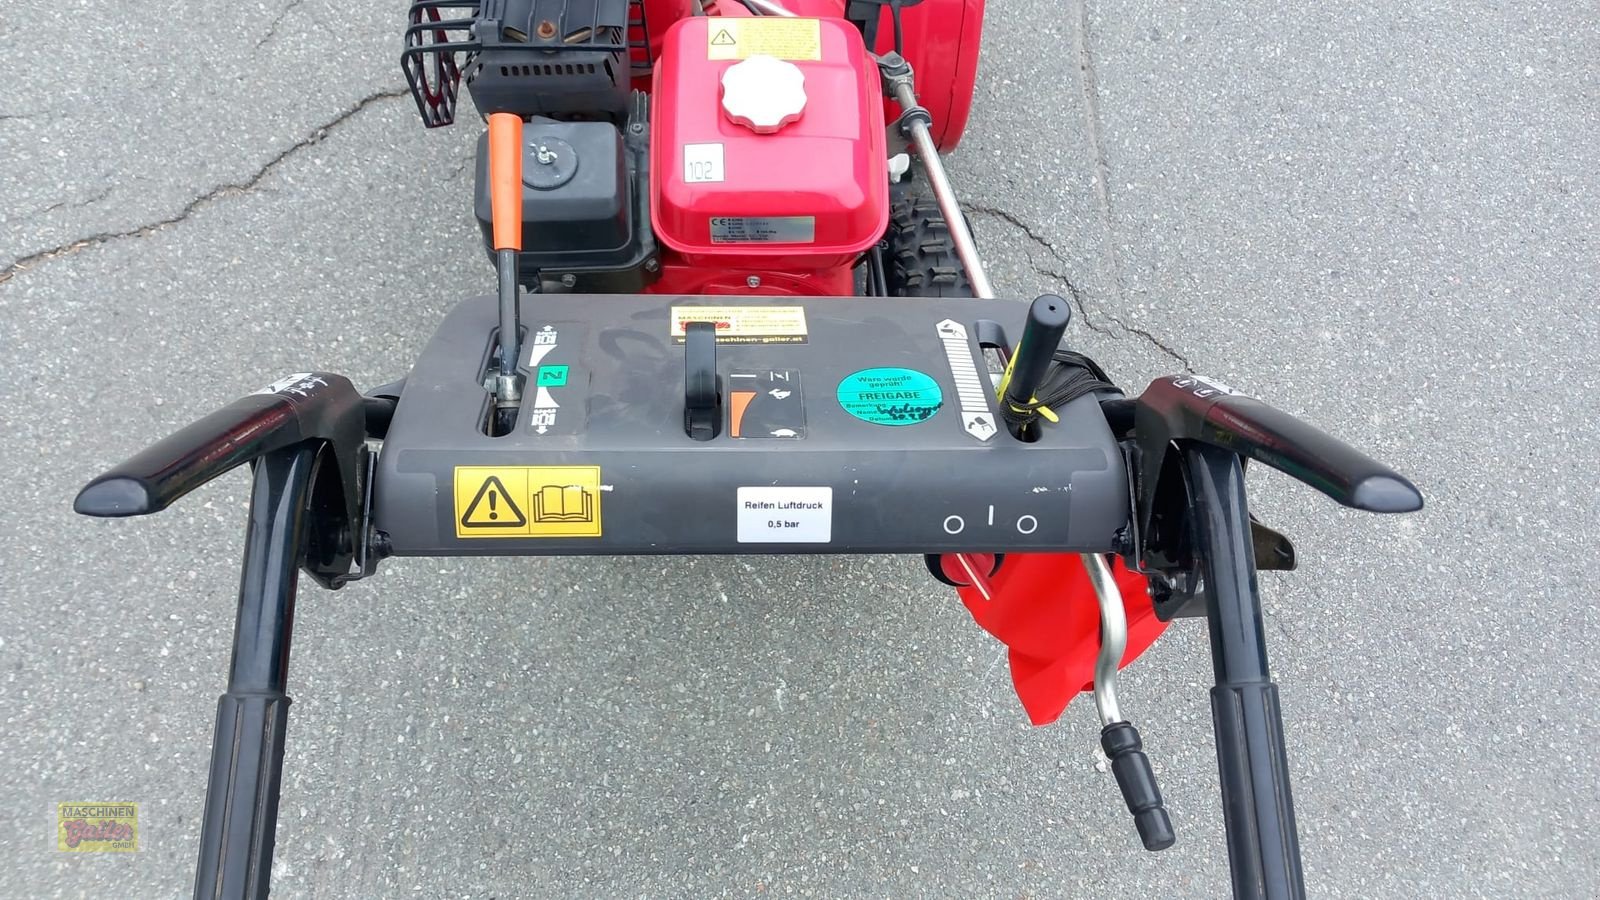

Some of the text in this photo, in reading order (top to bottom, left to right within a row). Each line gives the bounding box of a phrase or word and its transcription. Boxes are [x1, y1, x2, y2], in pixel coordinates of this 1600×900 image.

[689, 161, 713, 180] 102
[858, 391, 921, 400] FREIGABE
[744, 501, 824, 510] Reifen Luftdruck
[767, 520, 800, 529] 0,5 bar
